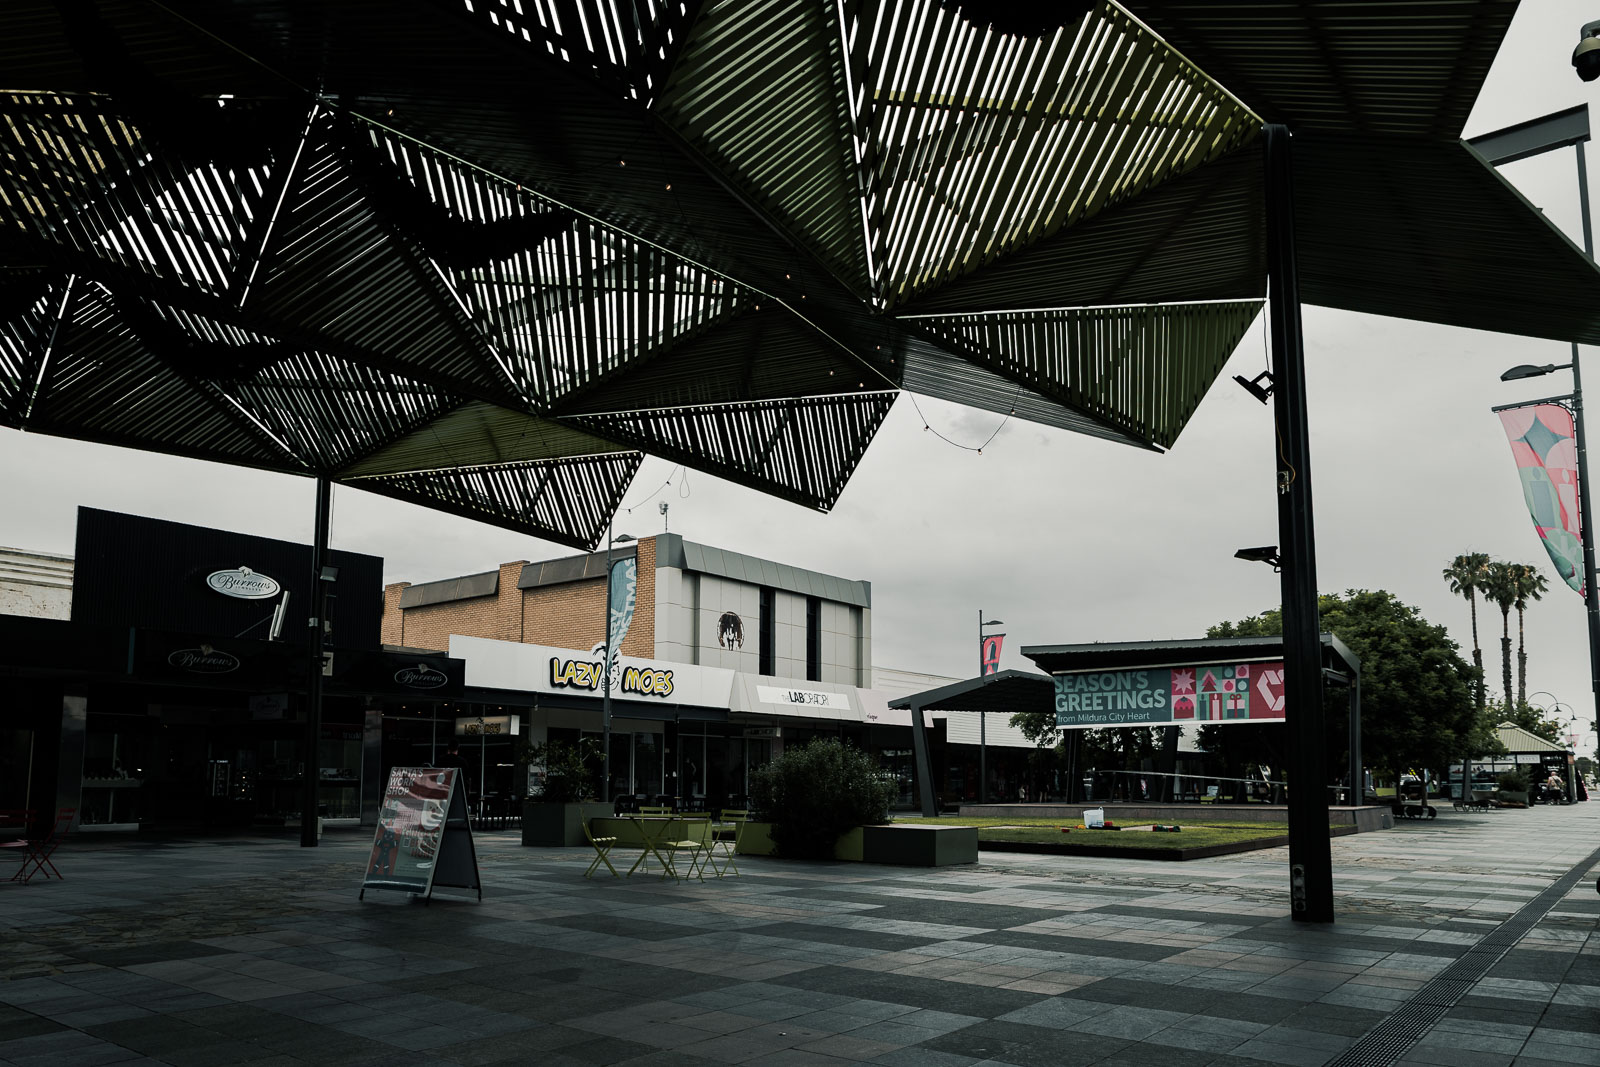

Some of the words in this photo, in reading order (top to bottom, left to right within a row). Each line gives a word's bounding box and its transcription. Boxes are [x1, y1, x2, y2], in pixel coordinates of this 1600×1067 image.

[218, 574, 271, 589] Burrows
[176, 653, 233, 668] Burrows
[400, 671, 444, 684] Burrows
[549, 657, 602, 691] LAZY
[622, 666, 674, 697] MOES
[1055, 671, 1149, 693] SEASON'S
[1055, 689, 1166, 712] GREETINGS
[1057, 714, 1076, 723] from
[1078, 713, 1107, 722] Mildura
[1108, 712, 1125, 722] City
[1127, 712, 1151, 721] Heart
[391, 768, 424, 778] SANTA'S
[389, 777, 415, 787] WORK
[387, 786, 410, 796] SHOP
